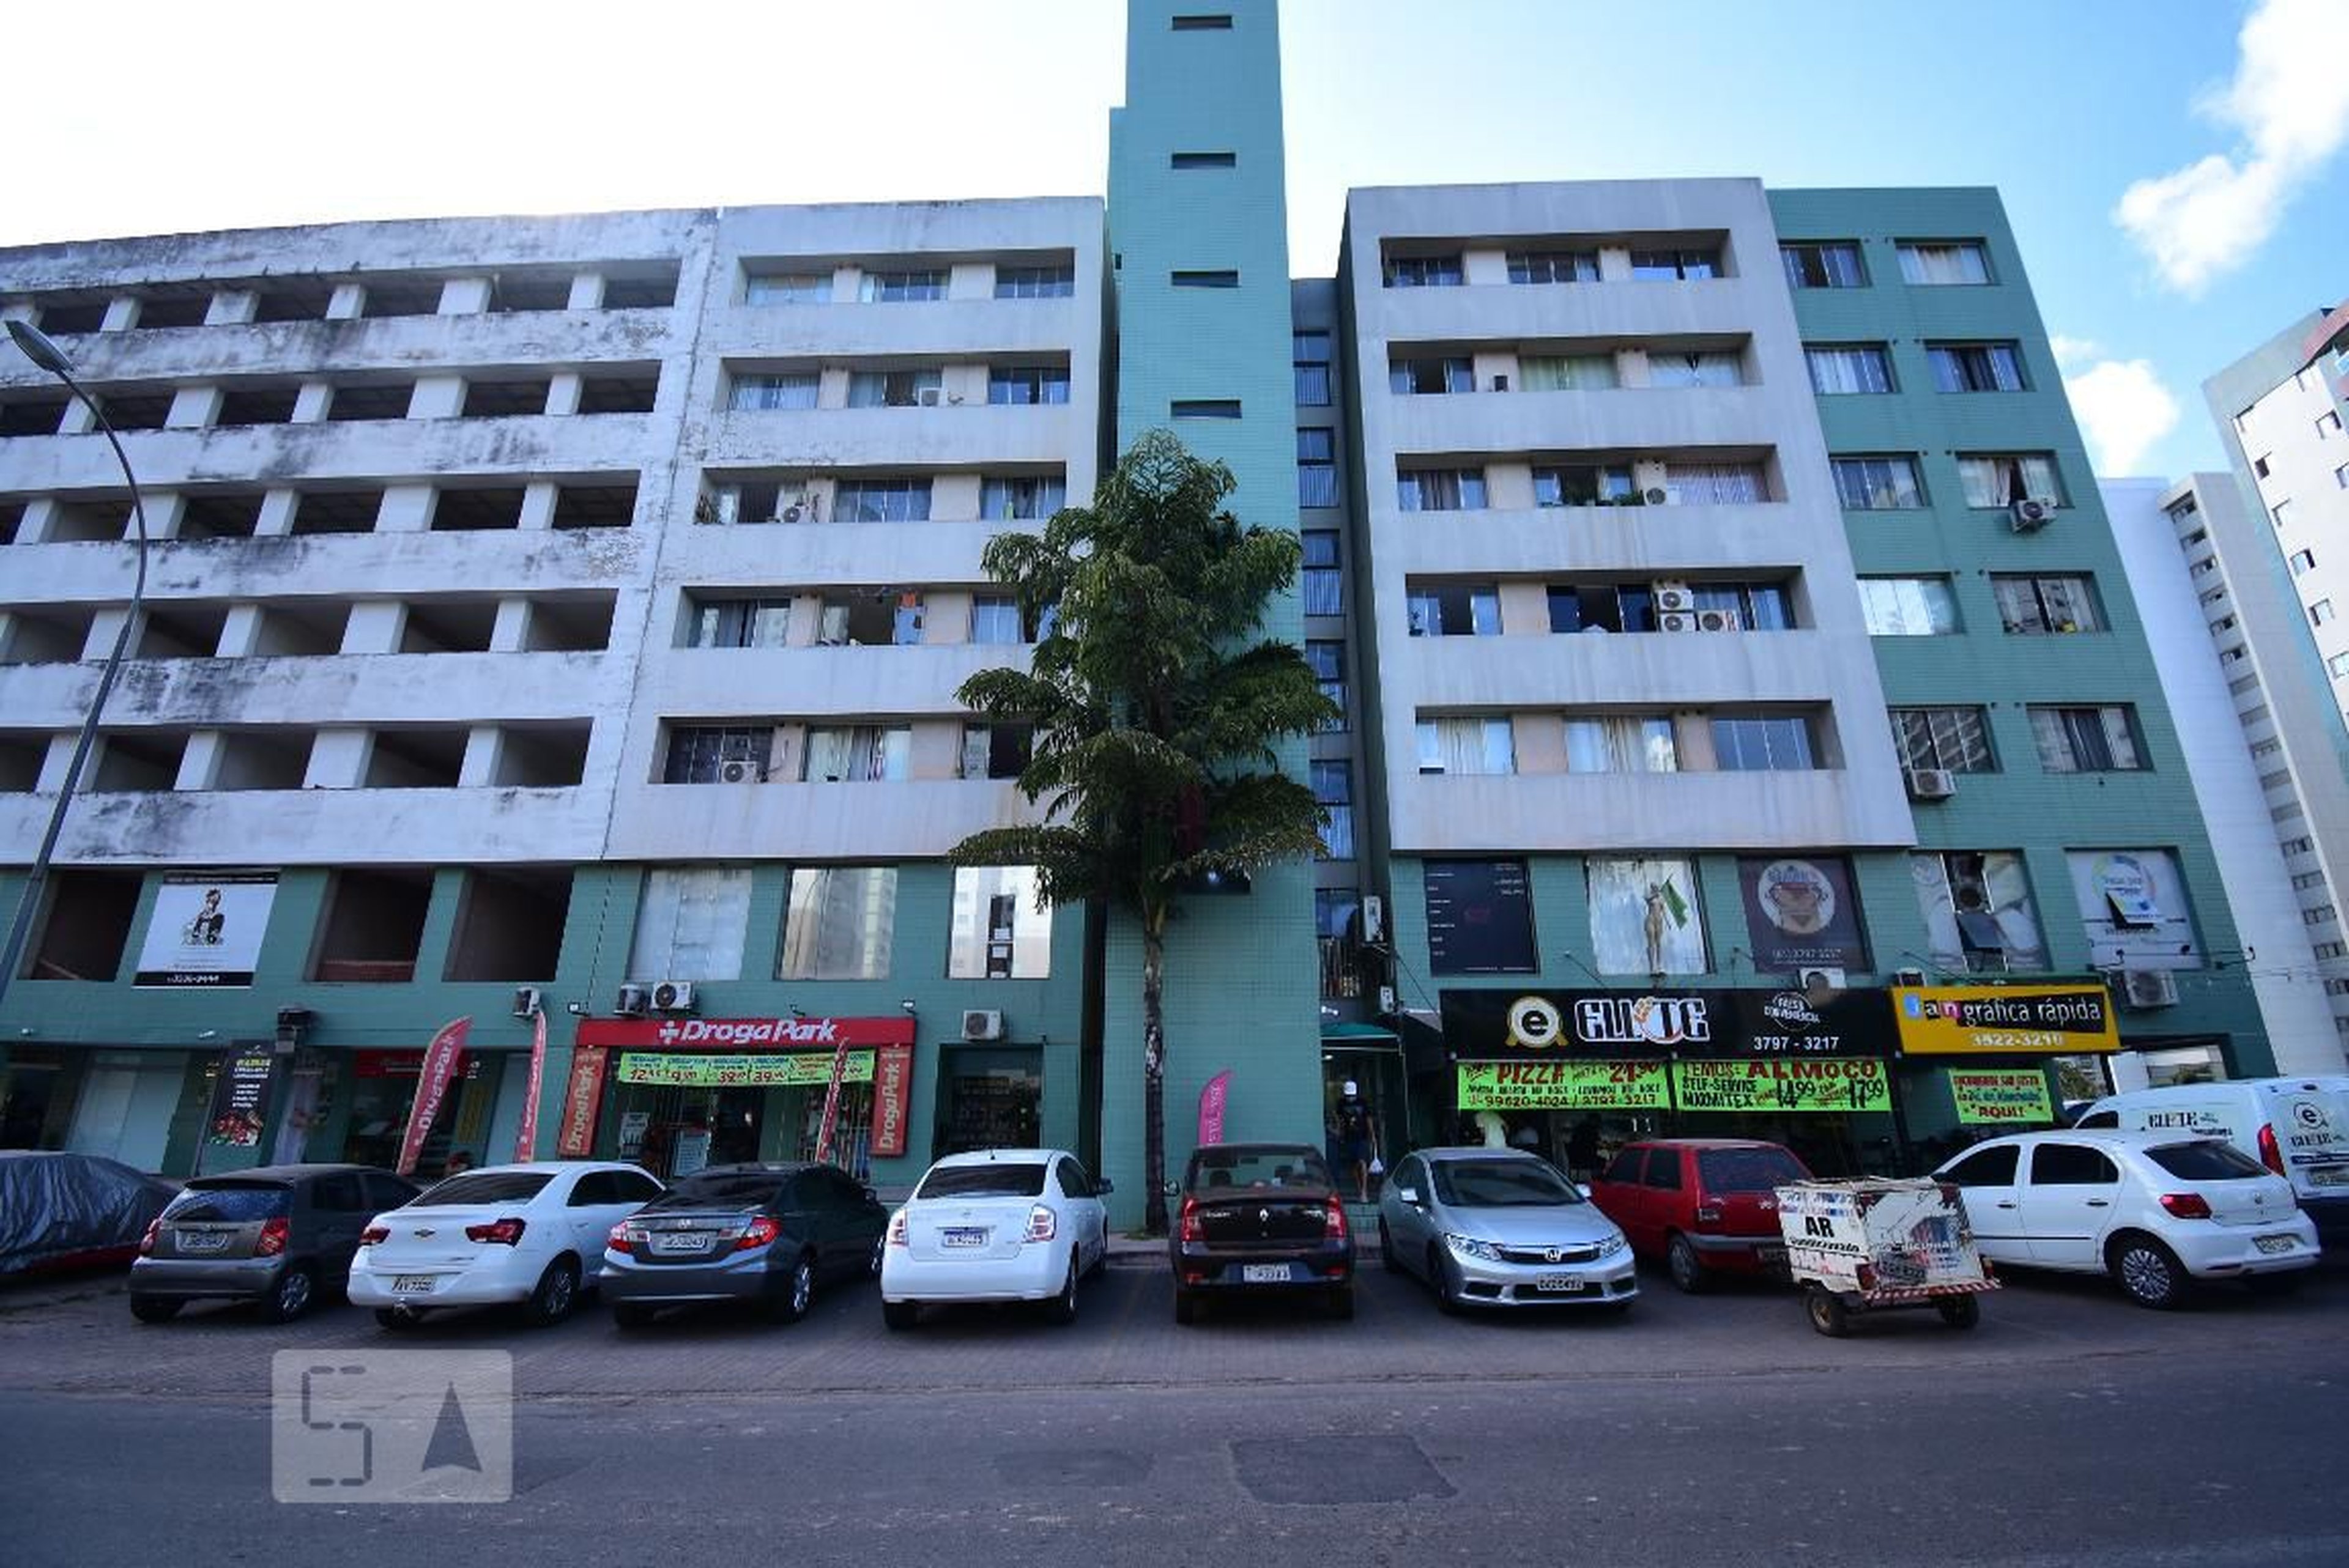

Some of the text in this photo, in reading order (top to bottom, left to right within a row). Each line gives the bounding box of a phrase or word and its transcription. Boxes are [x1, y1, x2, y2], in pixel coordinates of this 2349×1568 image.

[2038, 996, 2102, 1026] rápida
[1496, 1061, 1565, 1085] PIZZA
[1805, 1216, 1835, 1238] AR
